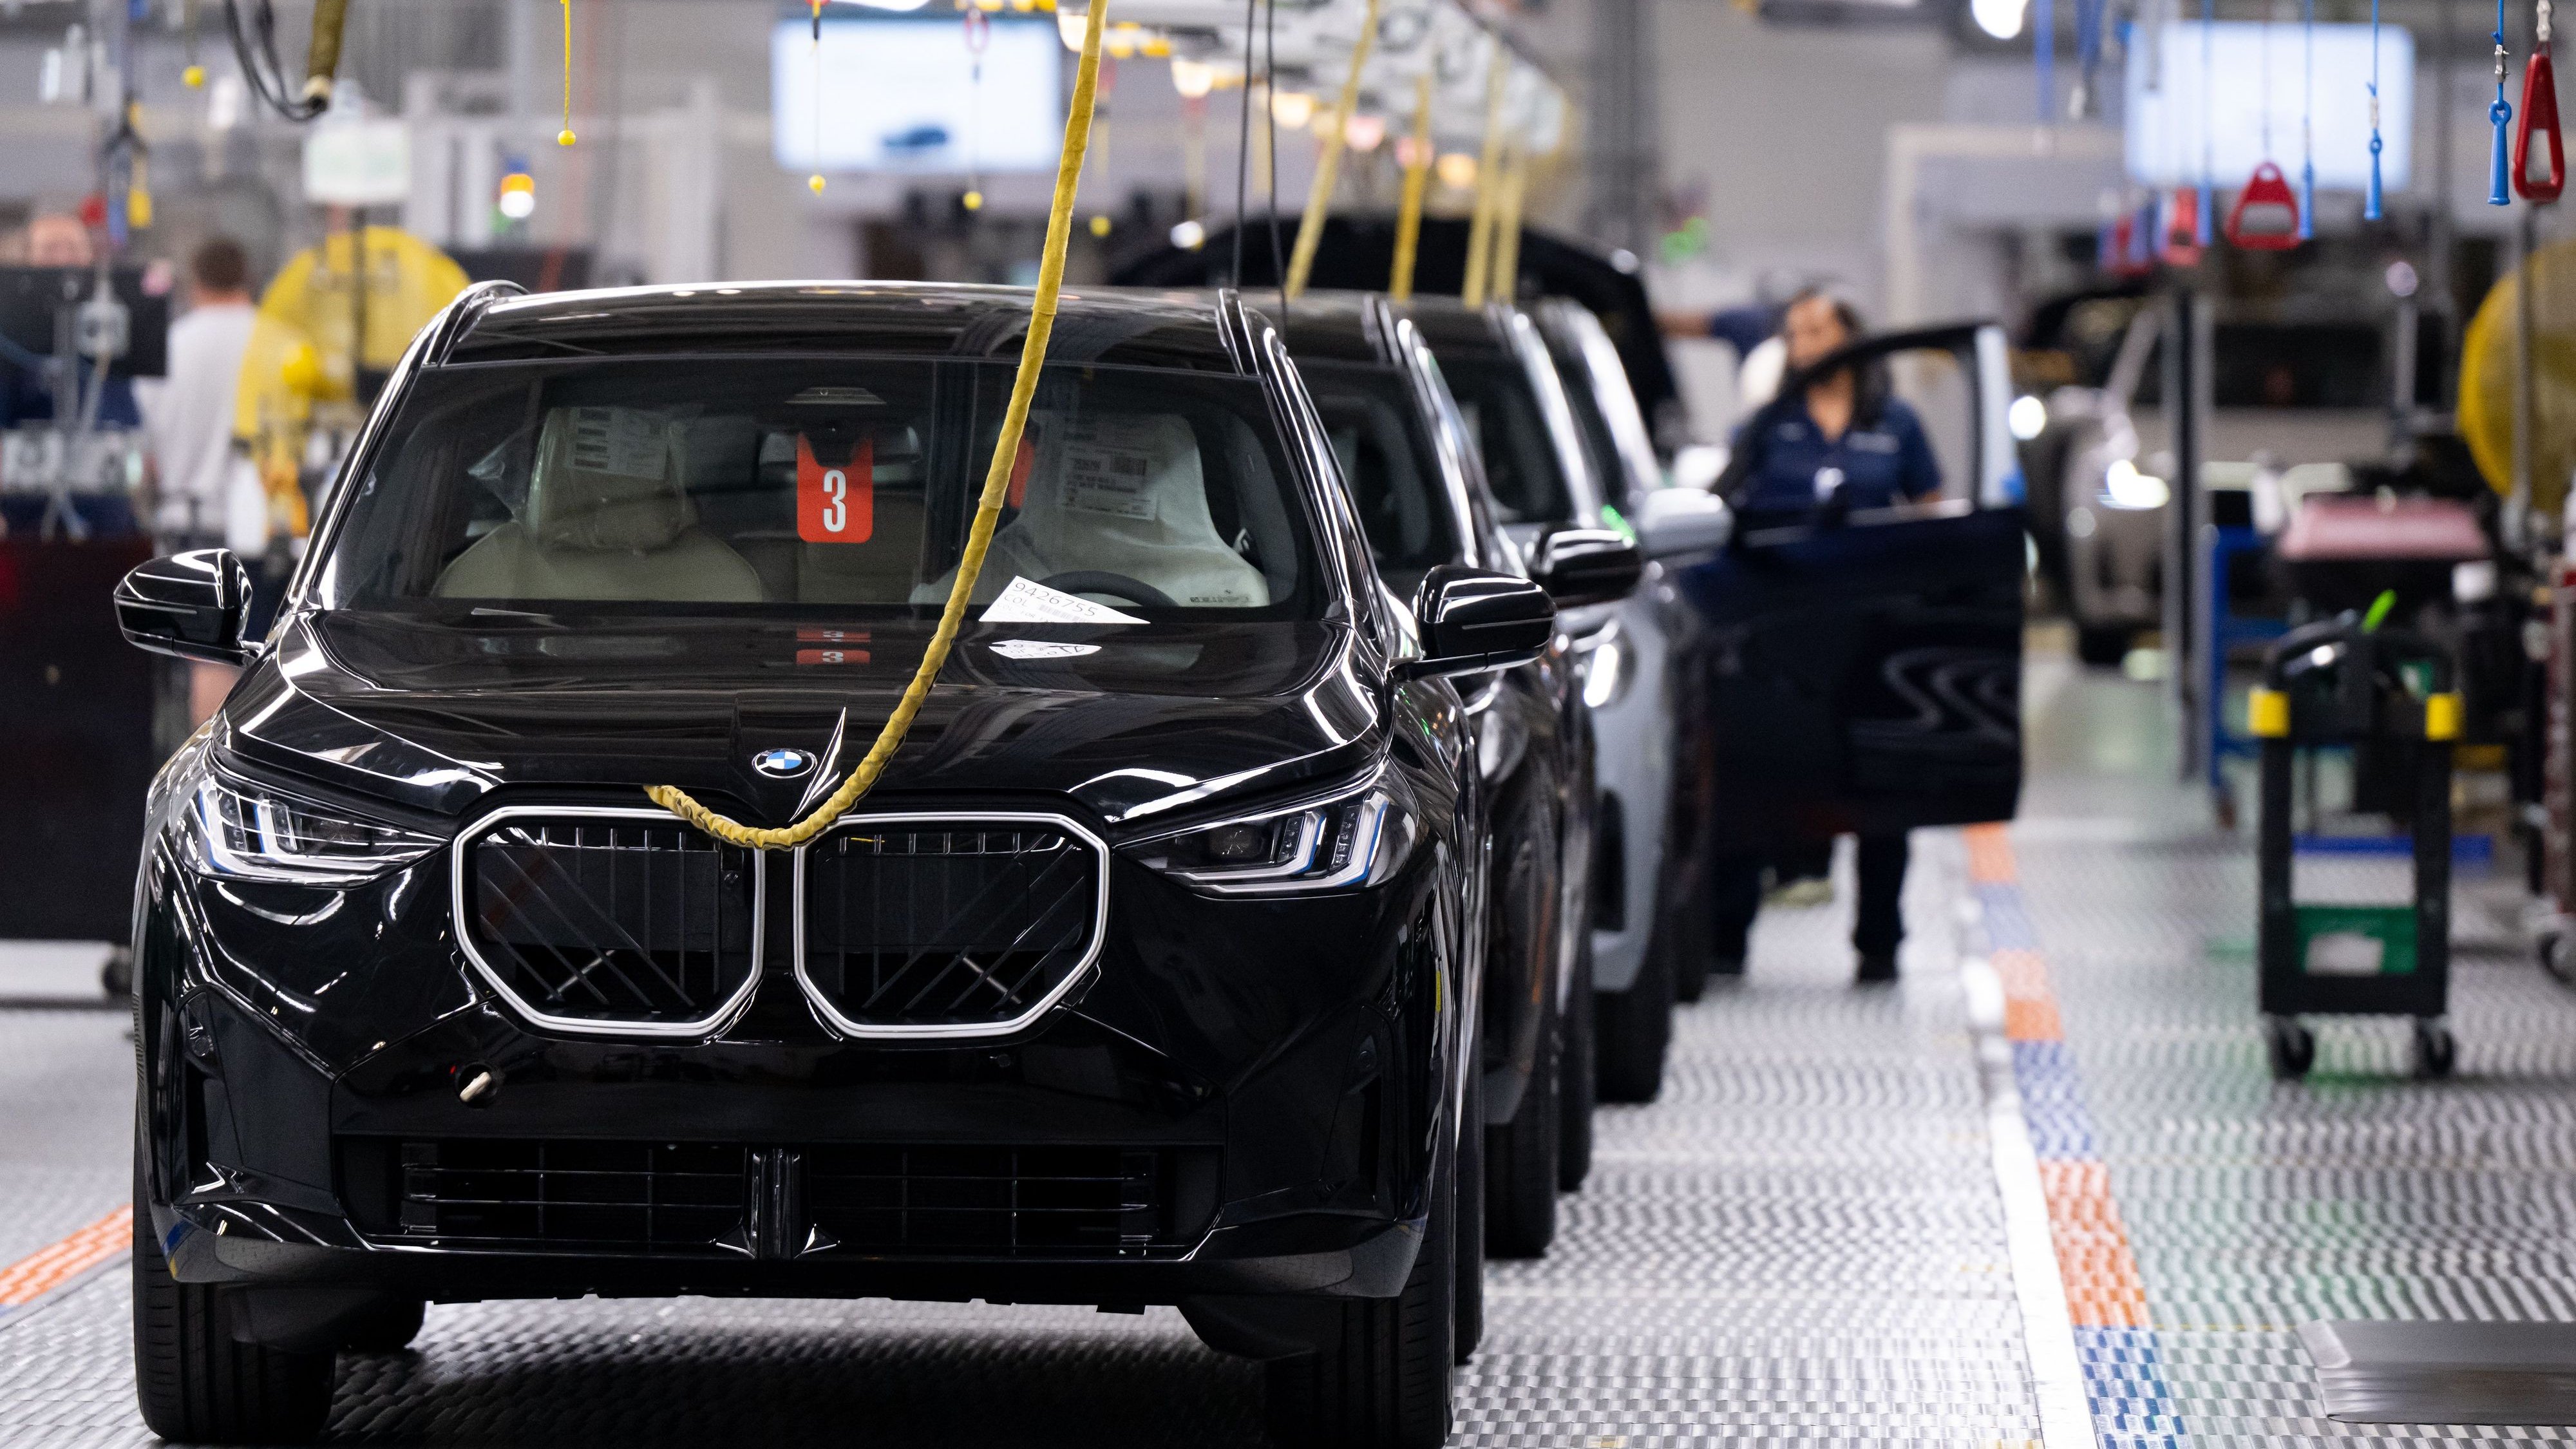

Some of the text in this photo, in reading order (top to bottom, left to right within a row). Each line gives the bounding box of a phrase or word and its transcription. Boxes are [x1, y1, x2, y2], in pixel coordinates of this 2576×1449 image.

[822, 469, 847, 533] 3
[1004, 594, 1027, 607] COL
[1012, 582, 1097, 616] 9426755
